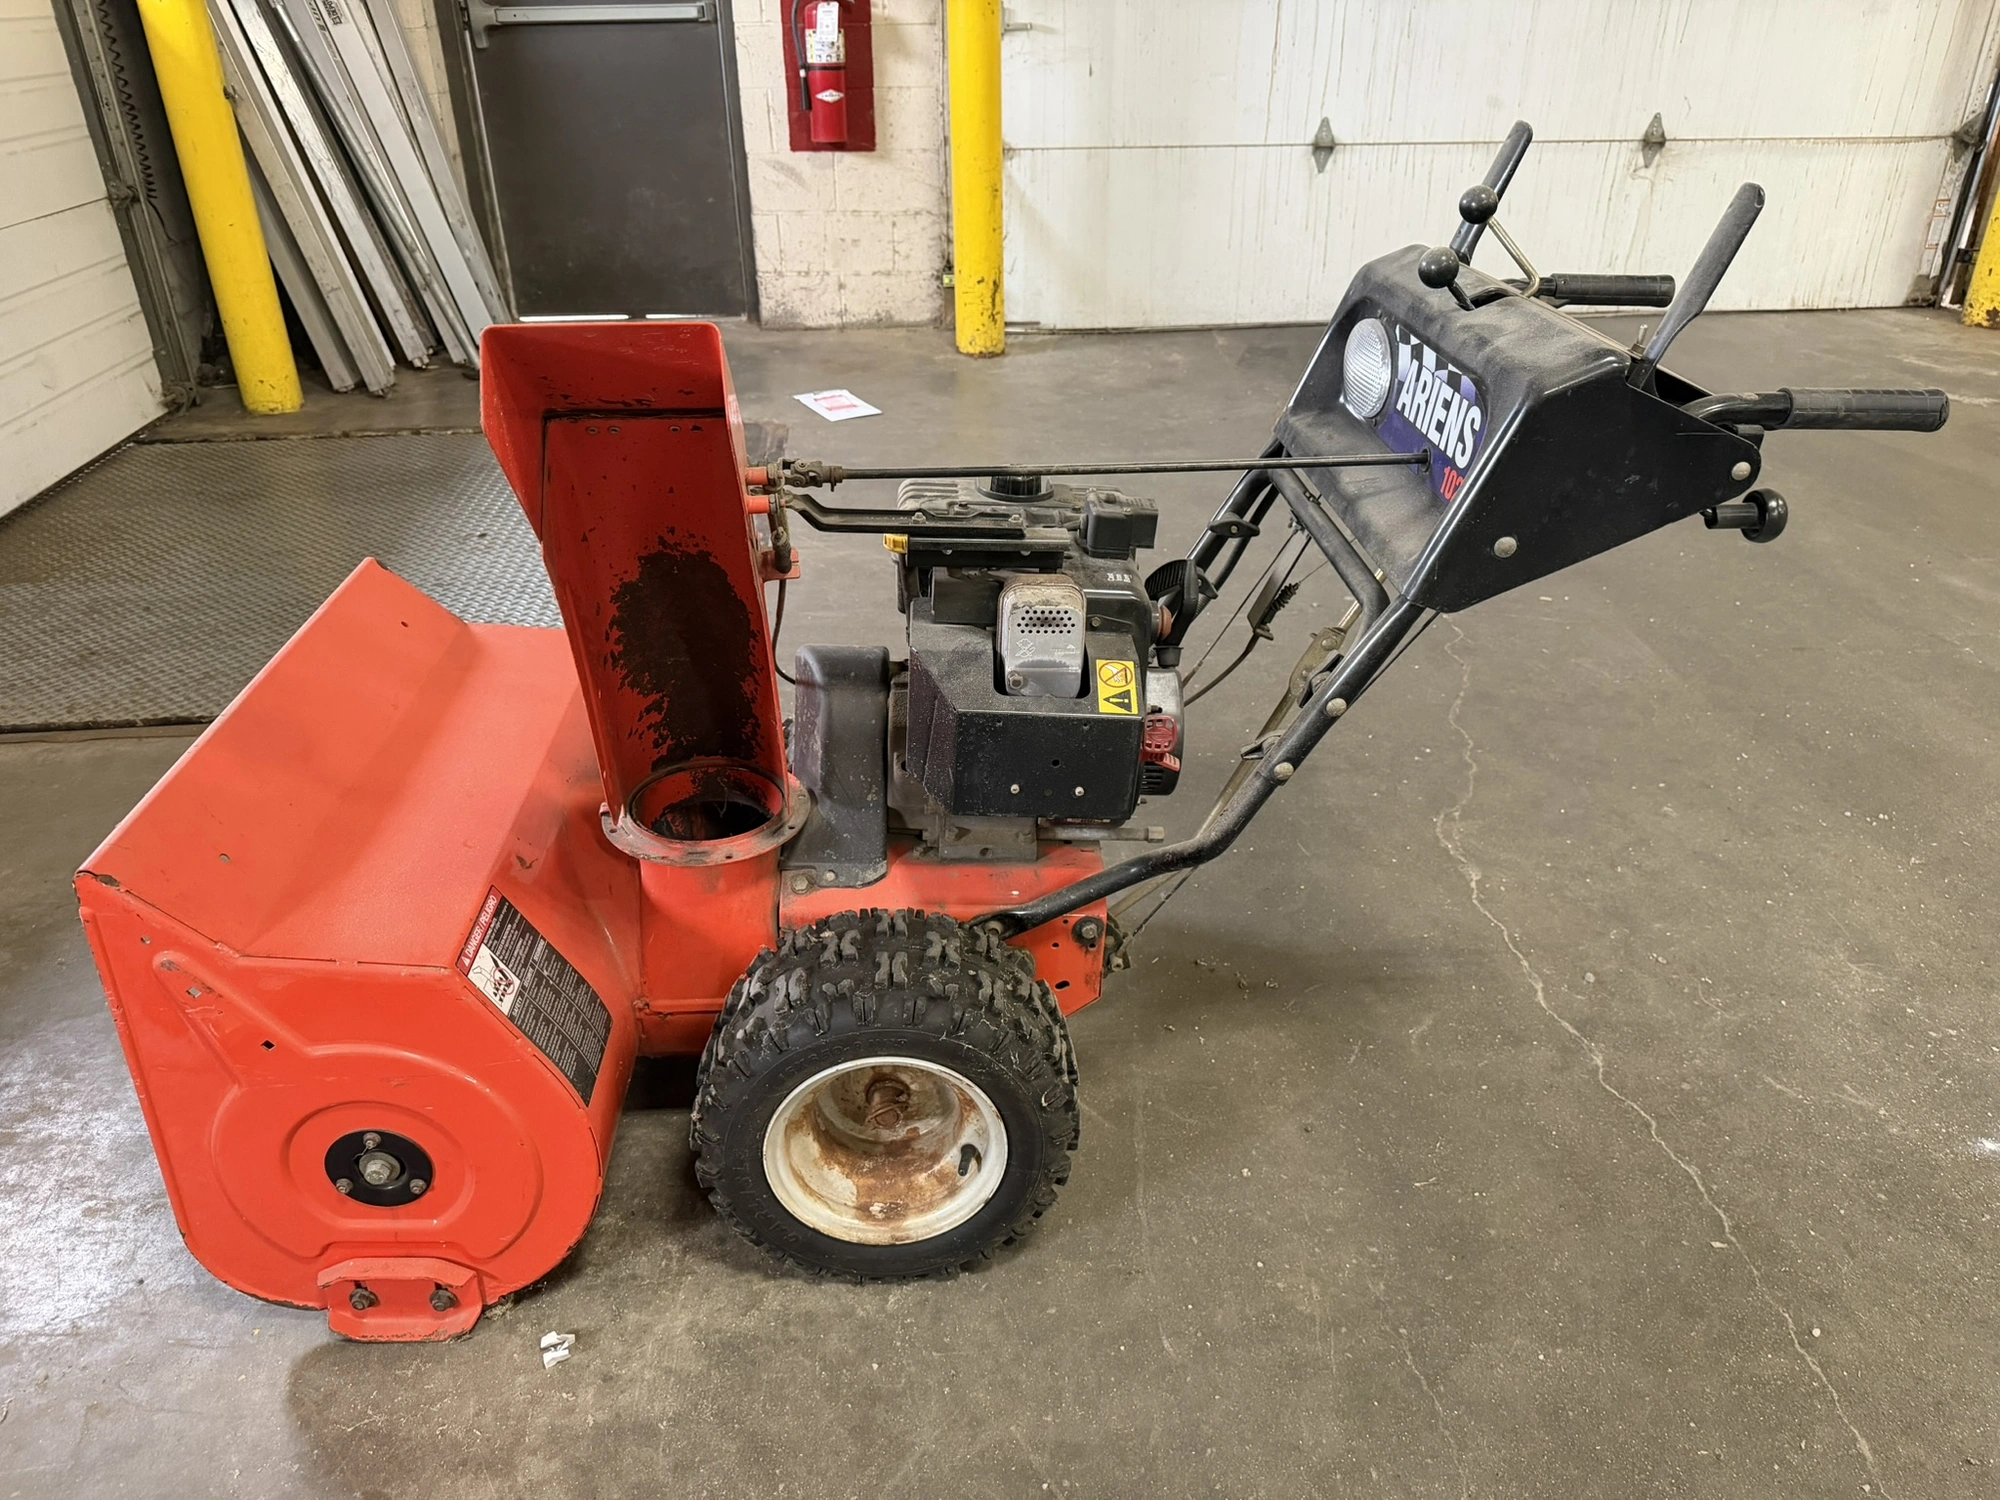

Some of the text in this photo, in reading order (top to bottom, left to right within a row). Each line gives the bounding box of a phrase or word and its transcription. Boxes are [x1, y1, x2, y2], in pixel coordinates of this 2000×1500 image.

[1396, 359, 1482, 469] ARIENS
[465, 925, 484, 957] DANGER
[480, 894, 498, 926] PELIGRO
[512, 995, 523, 1017] SAFETY
